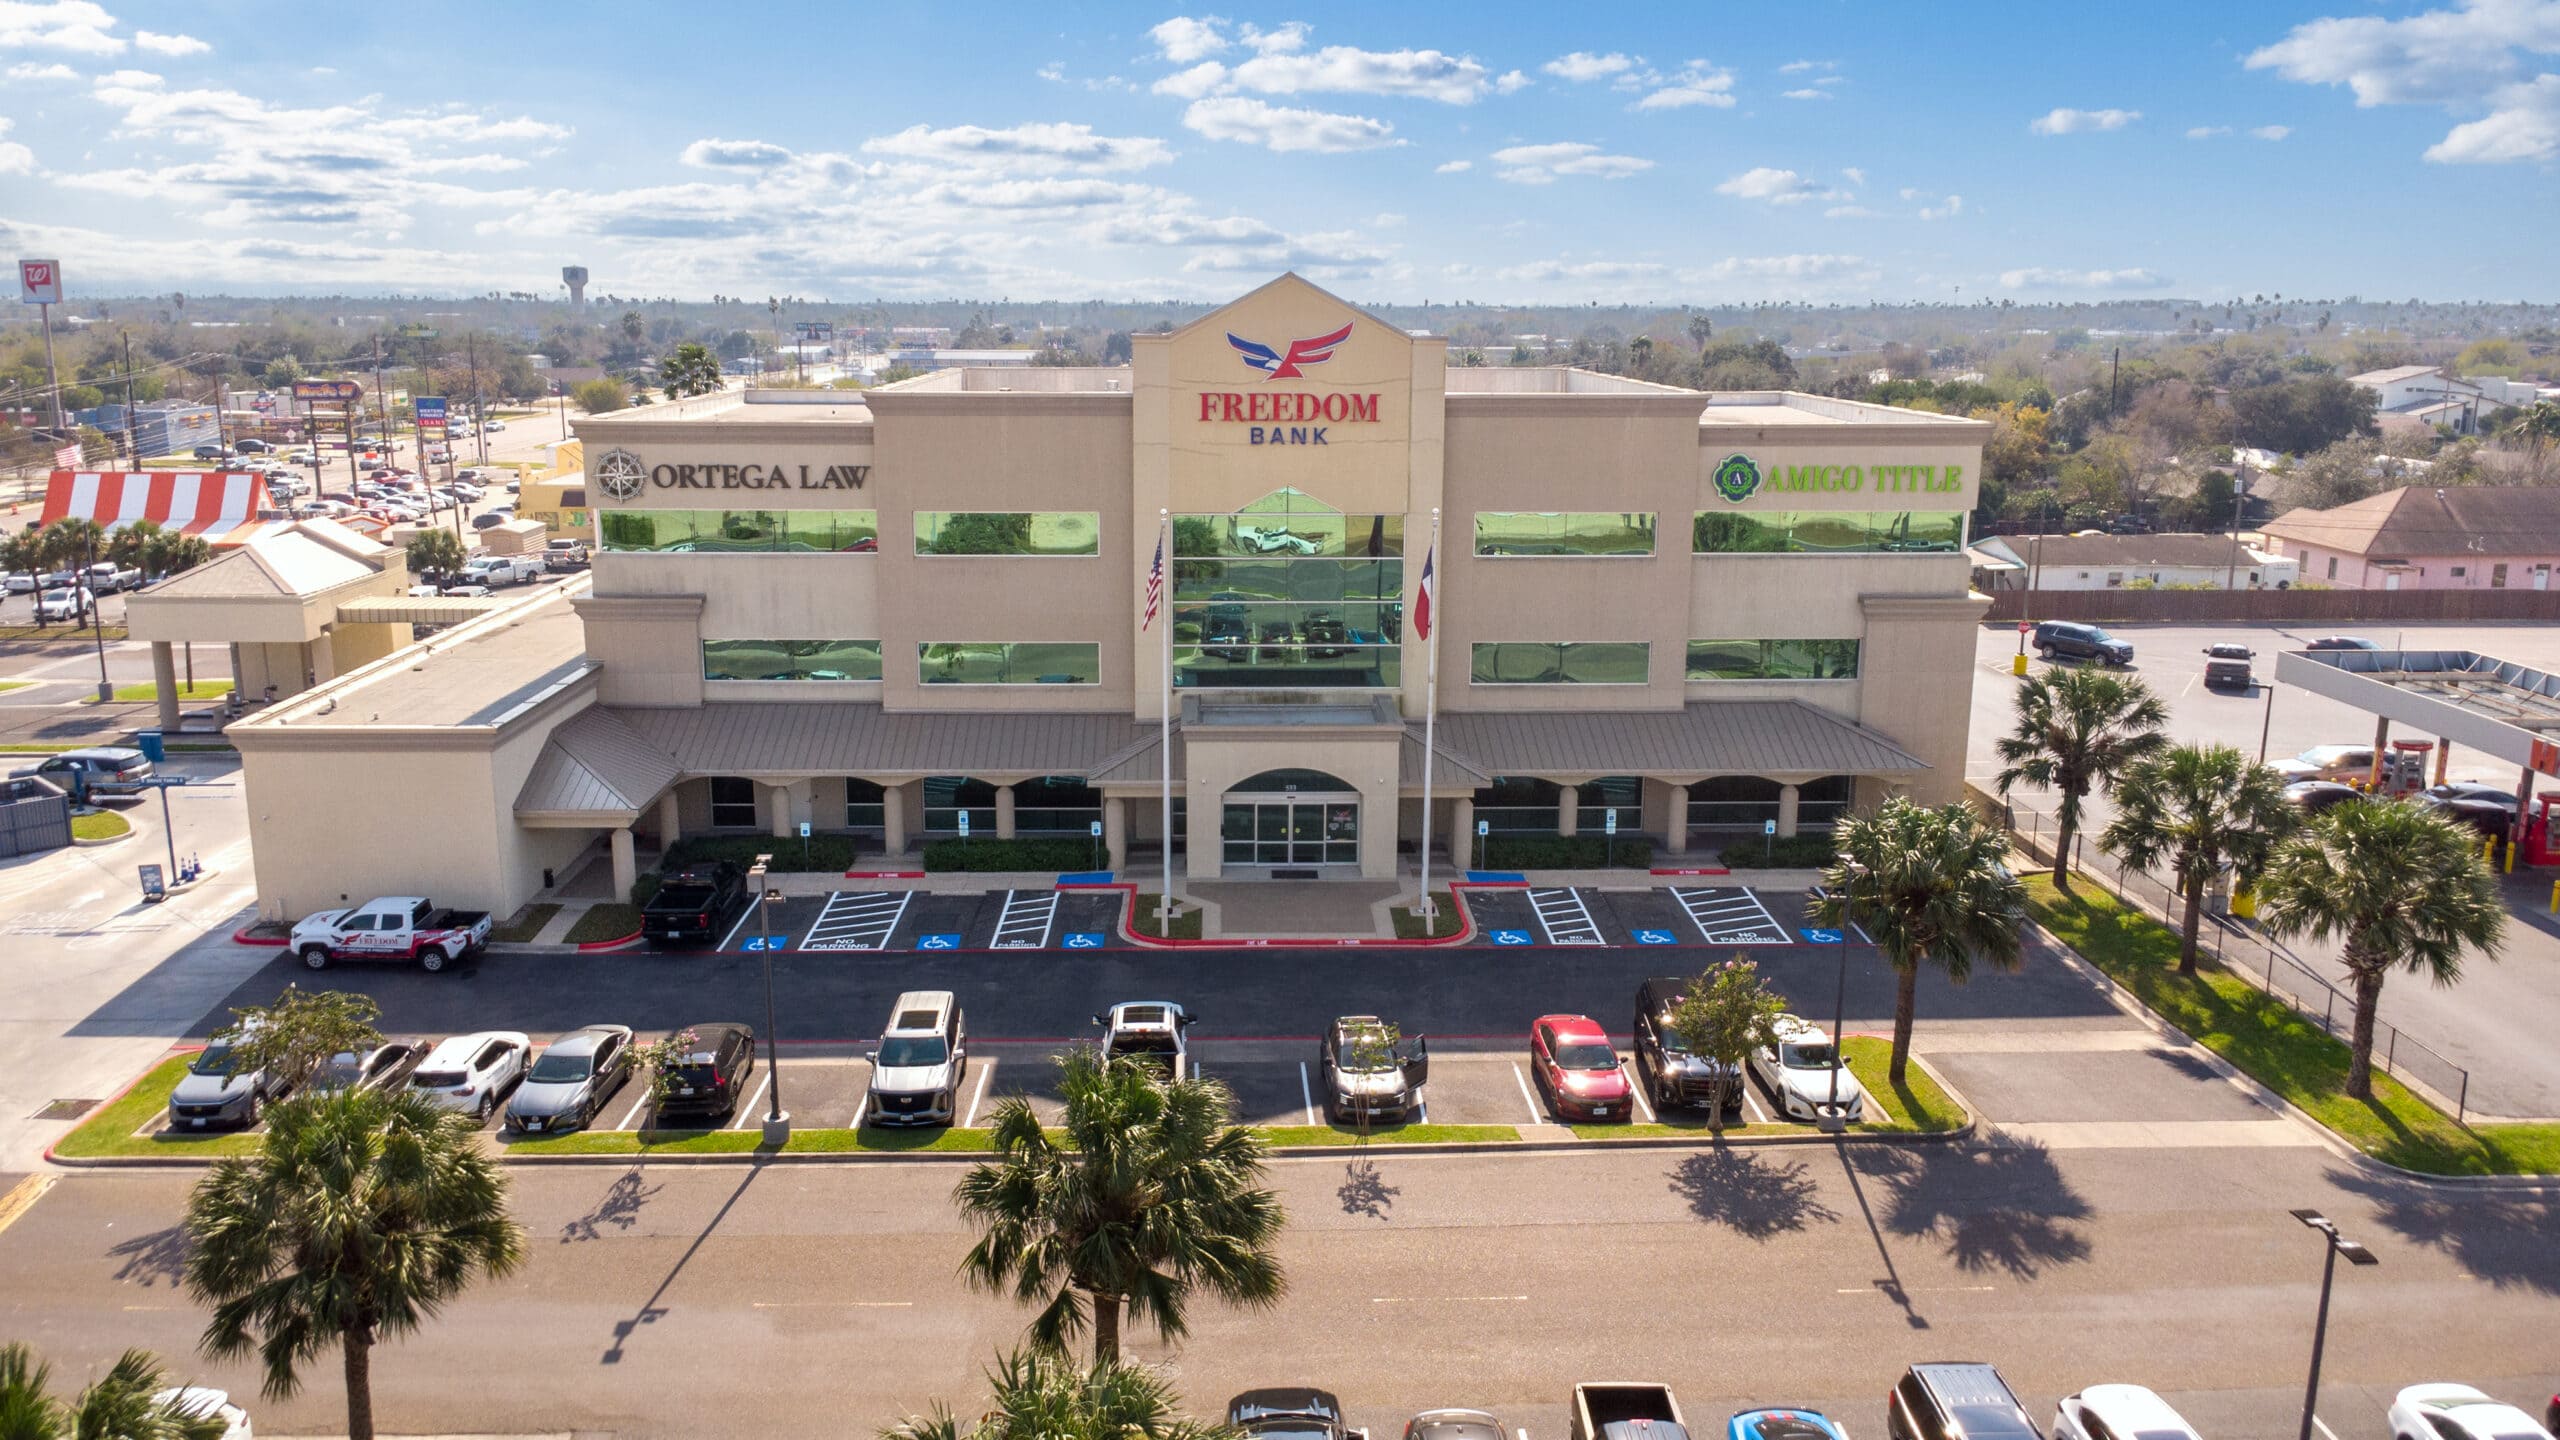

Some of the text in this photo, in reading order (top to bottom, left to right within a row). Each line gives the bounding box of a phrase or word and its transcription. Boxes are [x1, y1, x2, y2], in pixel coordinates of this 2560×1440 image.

[1198, 392, 1381, 422] FREEDOM
[1249, 427, 1329, 445] BANK
[652, 464, 871, 490] ORTEGA LAW
[1764, 464, 1963, 493] AMIGO TITLE
[359, 937, 398, 945] FREEDOM
